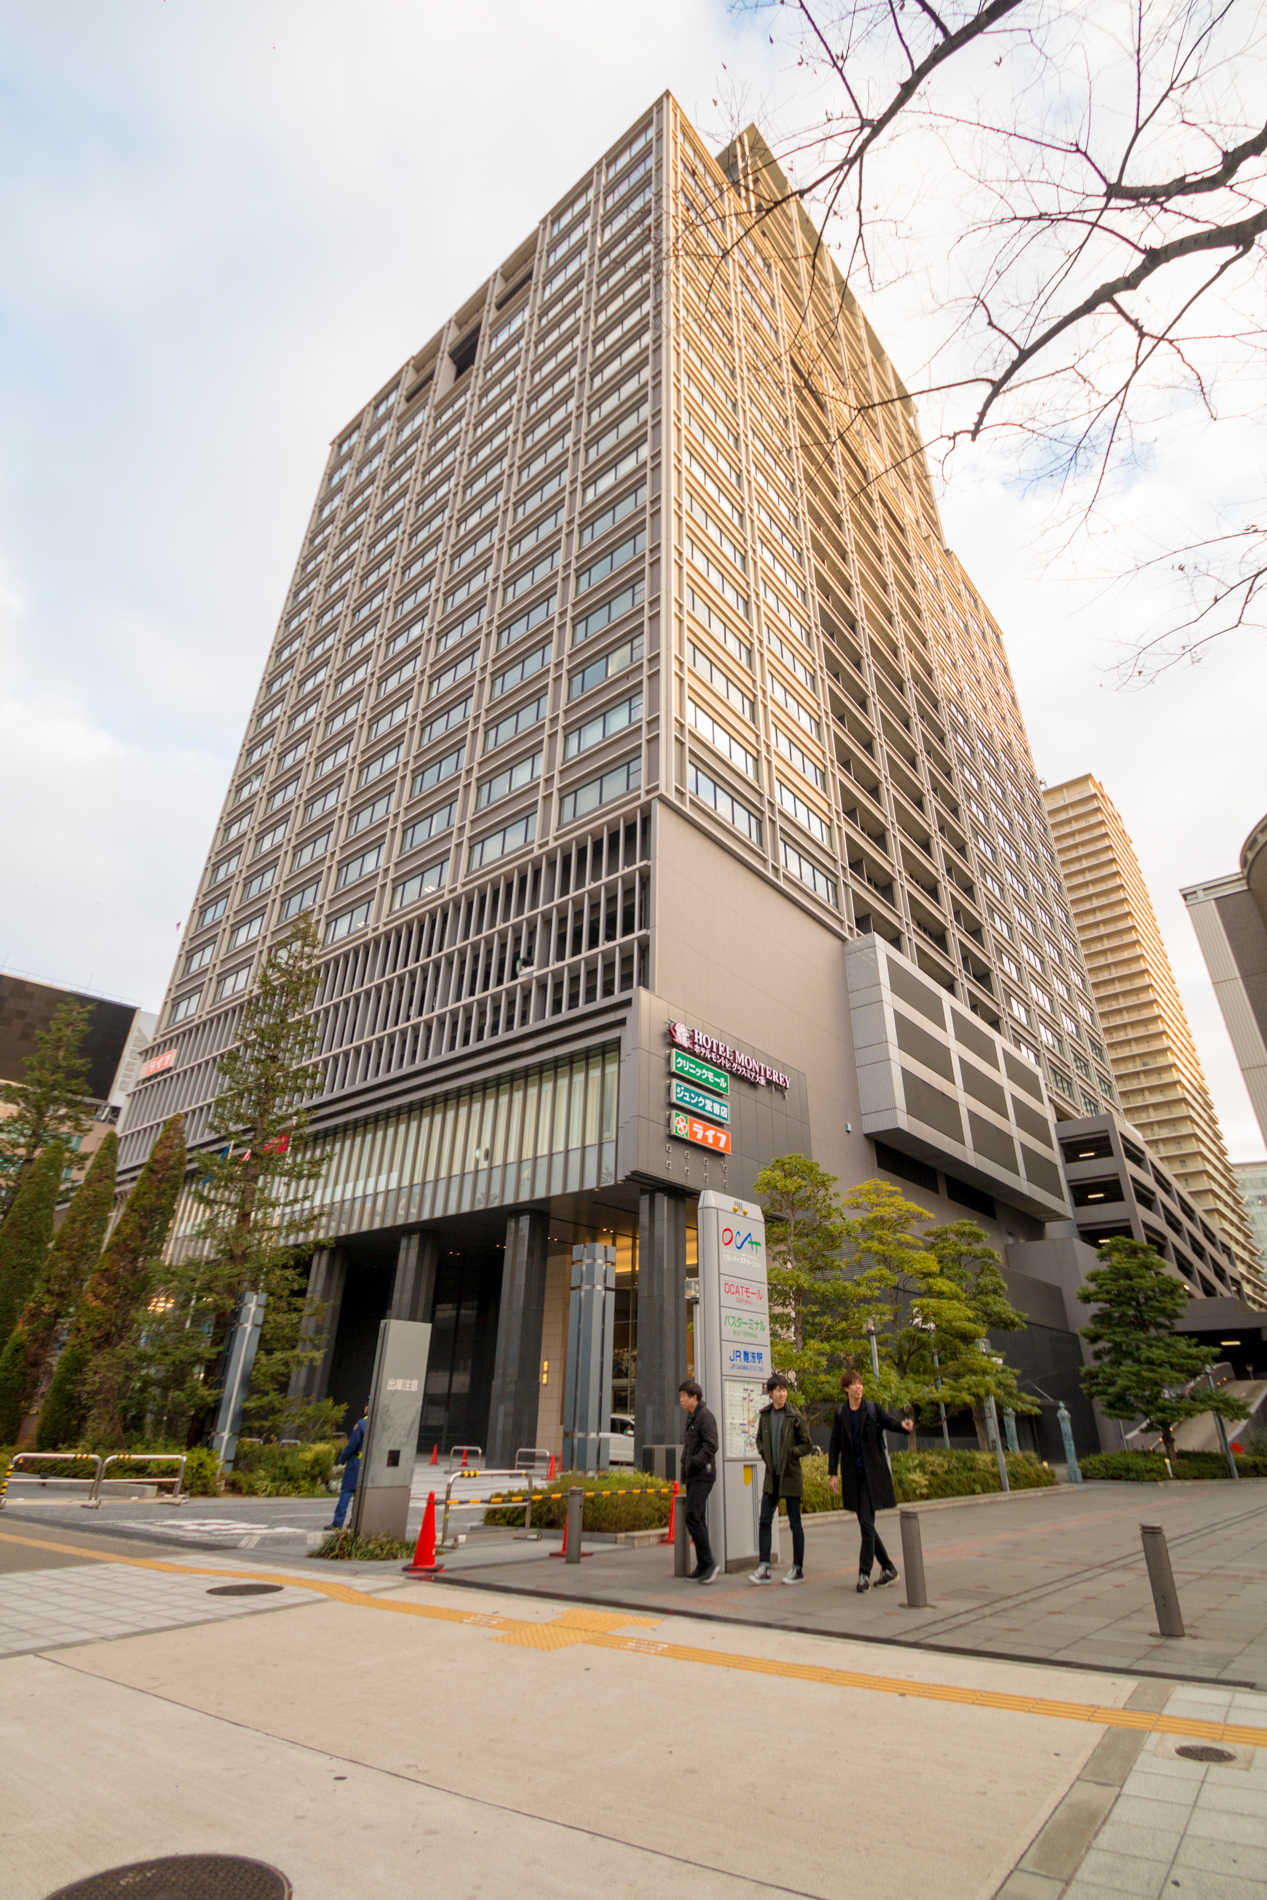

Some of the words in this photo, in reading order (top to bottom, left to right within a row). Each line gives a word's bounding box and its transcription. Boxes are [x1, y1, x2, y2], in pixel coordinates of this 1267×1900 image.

[149, 1053, 172, 1072] ライフ
[693, 1029, 733, 1060] HOTEL
[735, 1050, 791, 1089] MONTEREY
[676, 1057, 727, 1088] クリニックモール
[676, 1086, 728, 1119] ジュンク堂書店
[692, 1122, 727, 1148] ライフ
[721, 1227, 762, 1254] OCAT
[724, 1282, 763, 1300] OCATモール
[724, 1315, 766, 1332] バスターミナル
[729, 1349, 742, 1363] JR
[743, 1350, 763, 1365] 難波駅
[387, 1378, 418, 1391] 出庫注意
